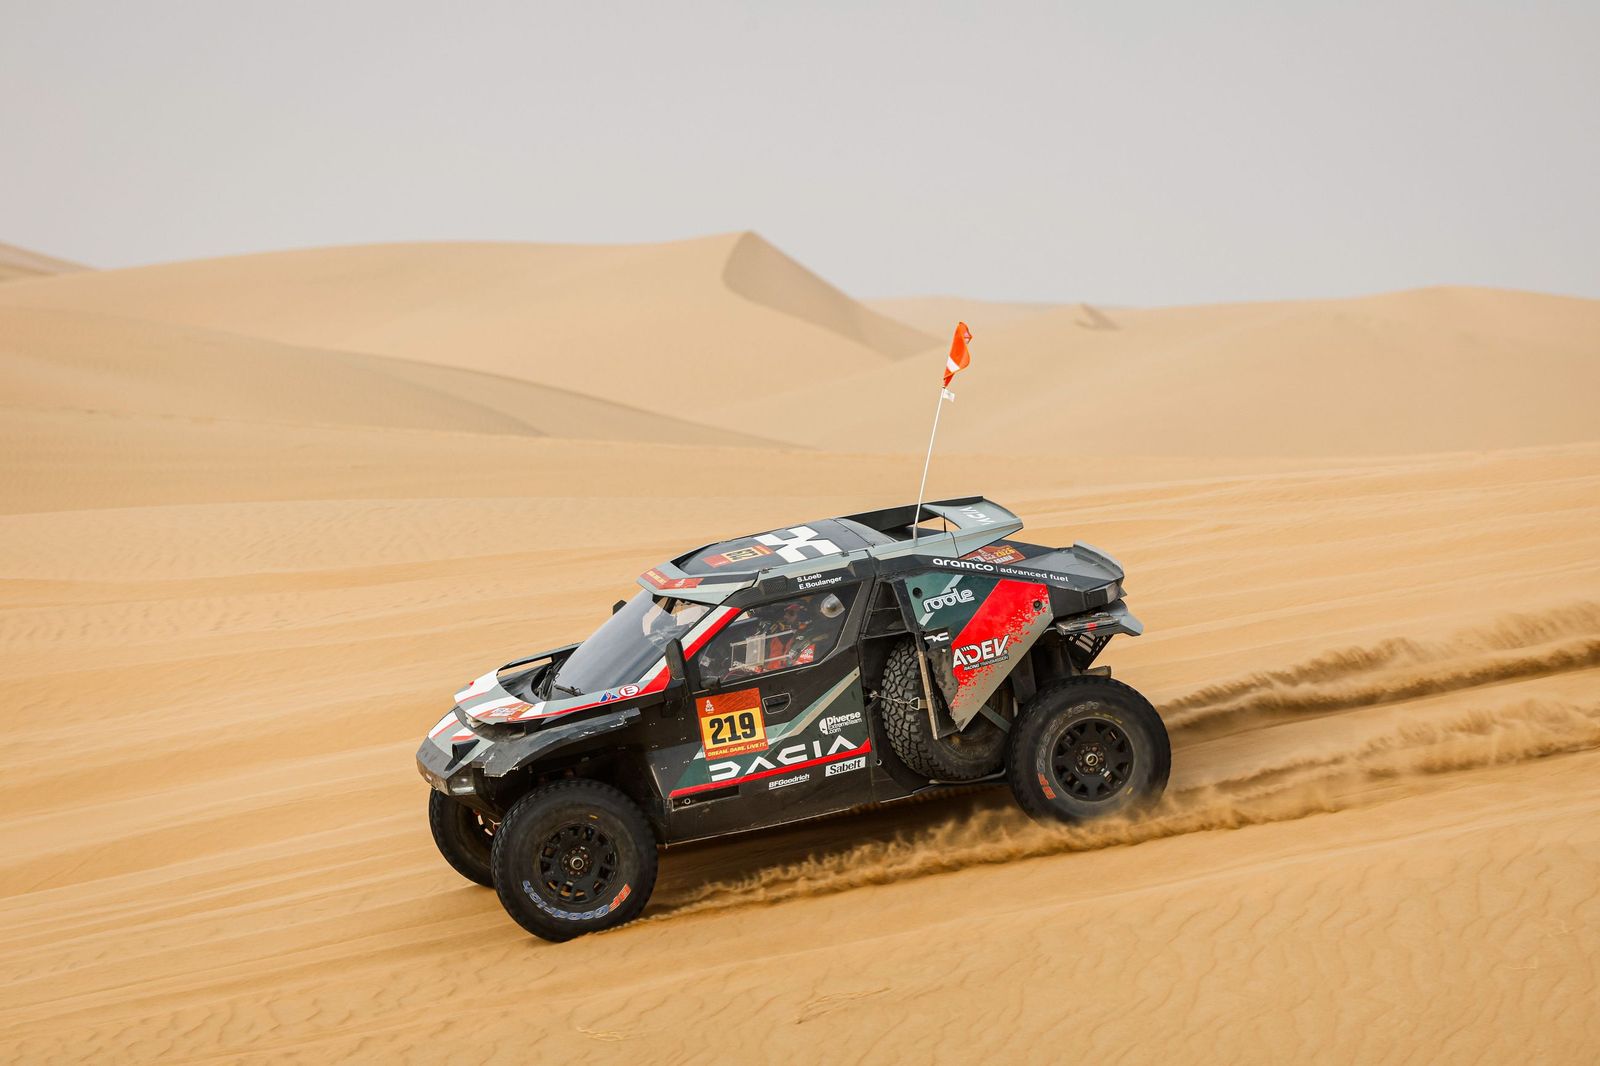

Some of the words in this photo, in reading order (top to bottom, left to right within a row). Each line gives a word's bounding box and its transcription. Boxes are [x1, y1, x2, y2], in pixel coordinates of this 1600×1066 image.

[796, 572, 822, 583] S.Loeb
[932, 557, 995, 572] aramco
[1000, 566, 1048, 579] advanced
[1049, 573, 1069, 583] fuel
[798, 576, 842, 590] E.Boulanger
[953, 634, 1010, 668] ADEV
[826, 711, 861, 726] Diverse
[708, 712, 757, 746] 219
[708, 735, 859, 782] DACIA
[829, 759, 863, 775] Sabelt
[768, 773, 810, 788] BFGoodrich
